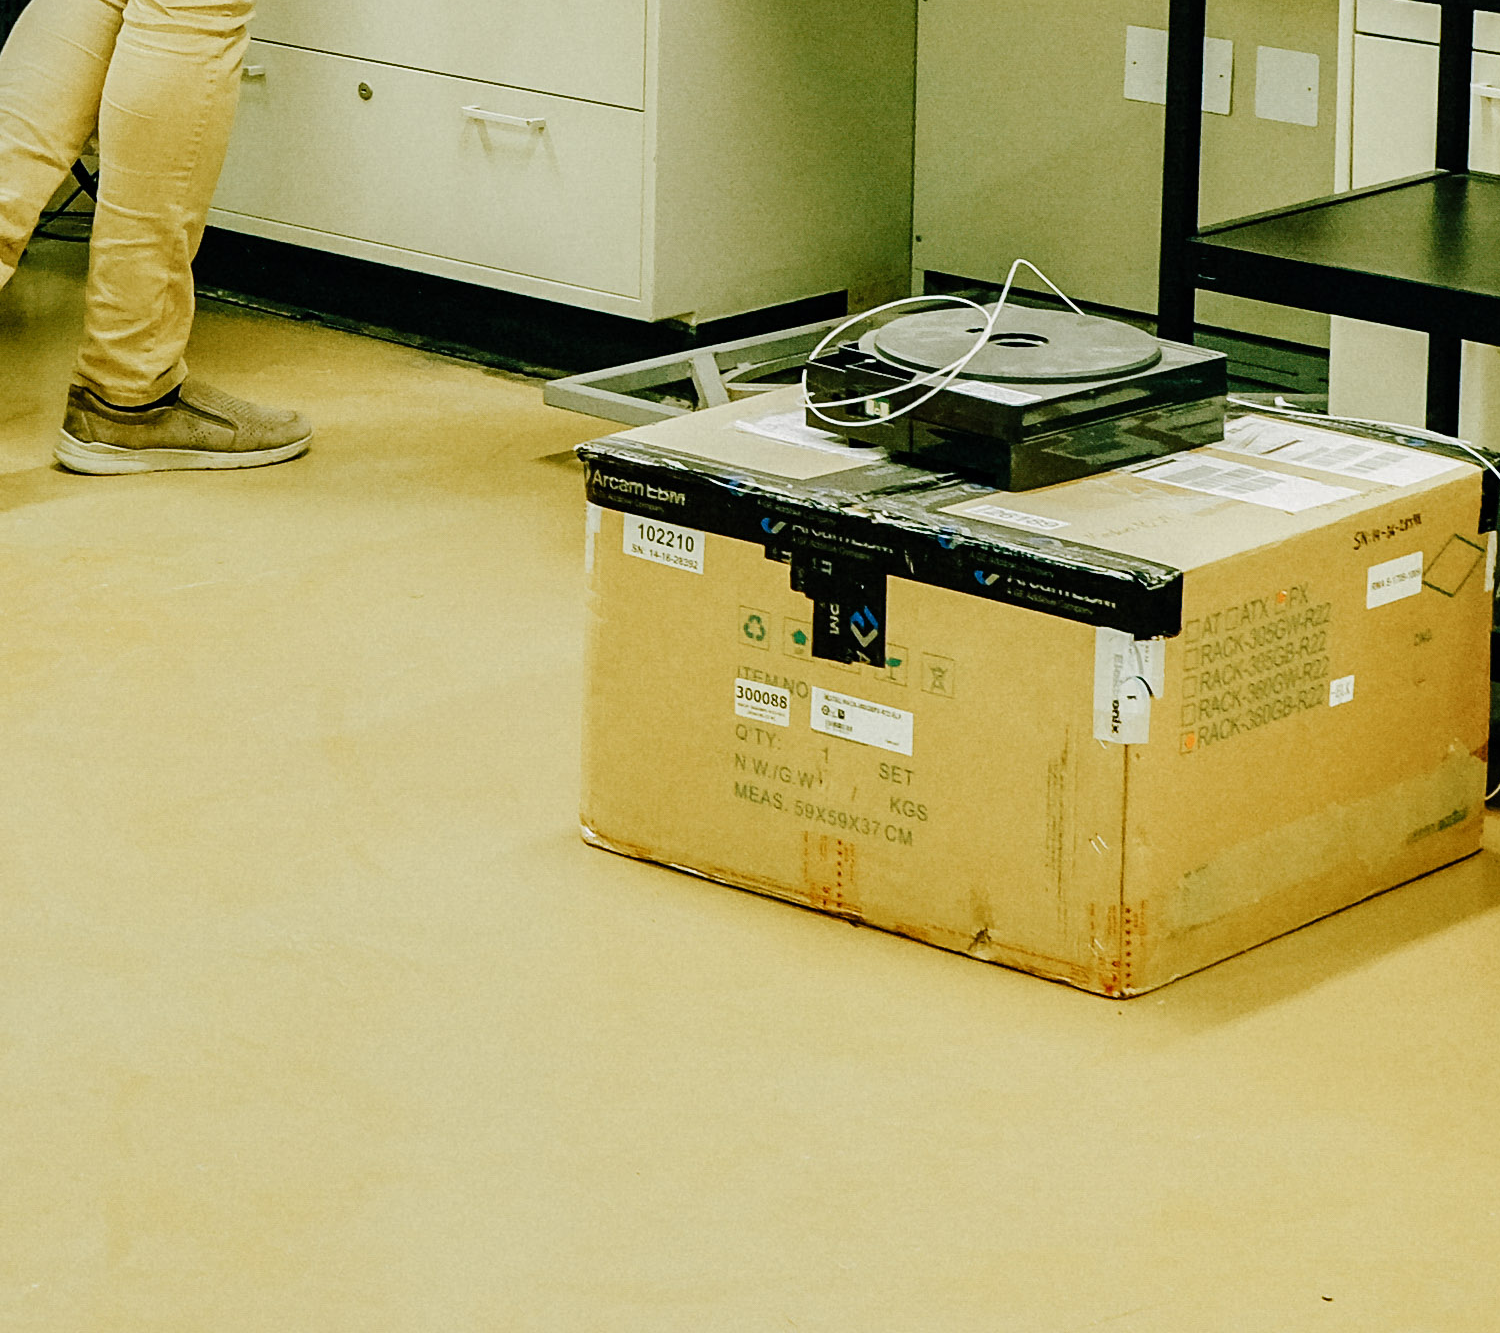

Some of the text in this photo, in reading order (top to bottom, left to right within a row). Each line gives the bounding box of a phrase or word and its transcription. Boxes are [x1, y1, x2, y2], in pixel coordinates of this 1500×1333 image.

[592, 469, 645, 497] Arcam
[637, 523, 696, 553] 102210
[736, 685, 788, 710] 300088
[878, 762, 914, 786] SET
[889, 797, 929, 822] KGS
[884, 824, 913, 847] CM
